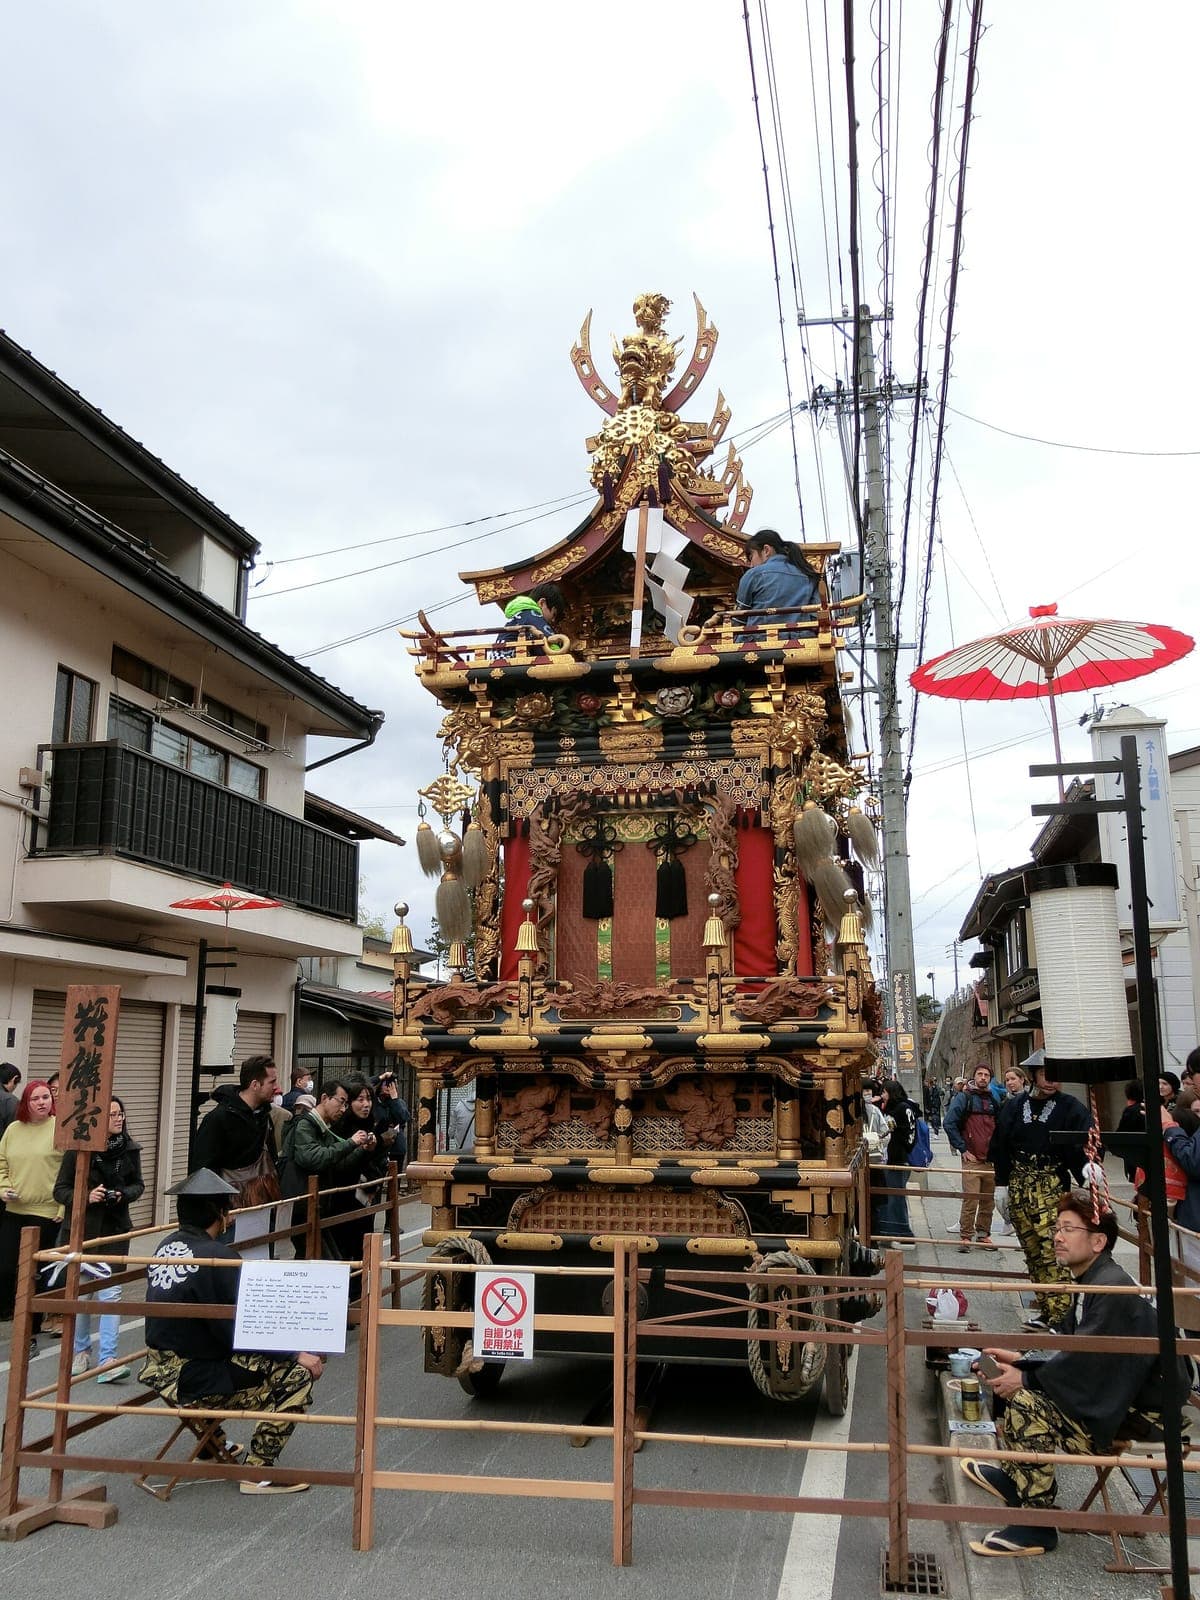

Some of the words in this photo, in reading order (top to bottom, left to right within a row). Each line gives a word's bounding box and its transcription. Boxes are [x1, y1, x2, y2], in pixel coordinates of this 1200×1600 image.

[900, 1037, 911, 1049] P
[484, 1327, 524, 1340] 自撮り棒
[483, 1339, 523, 1351] 使用禁止
